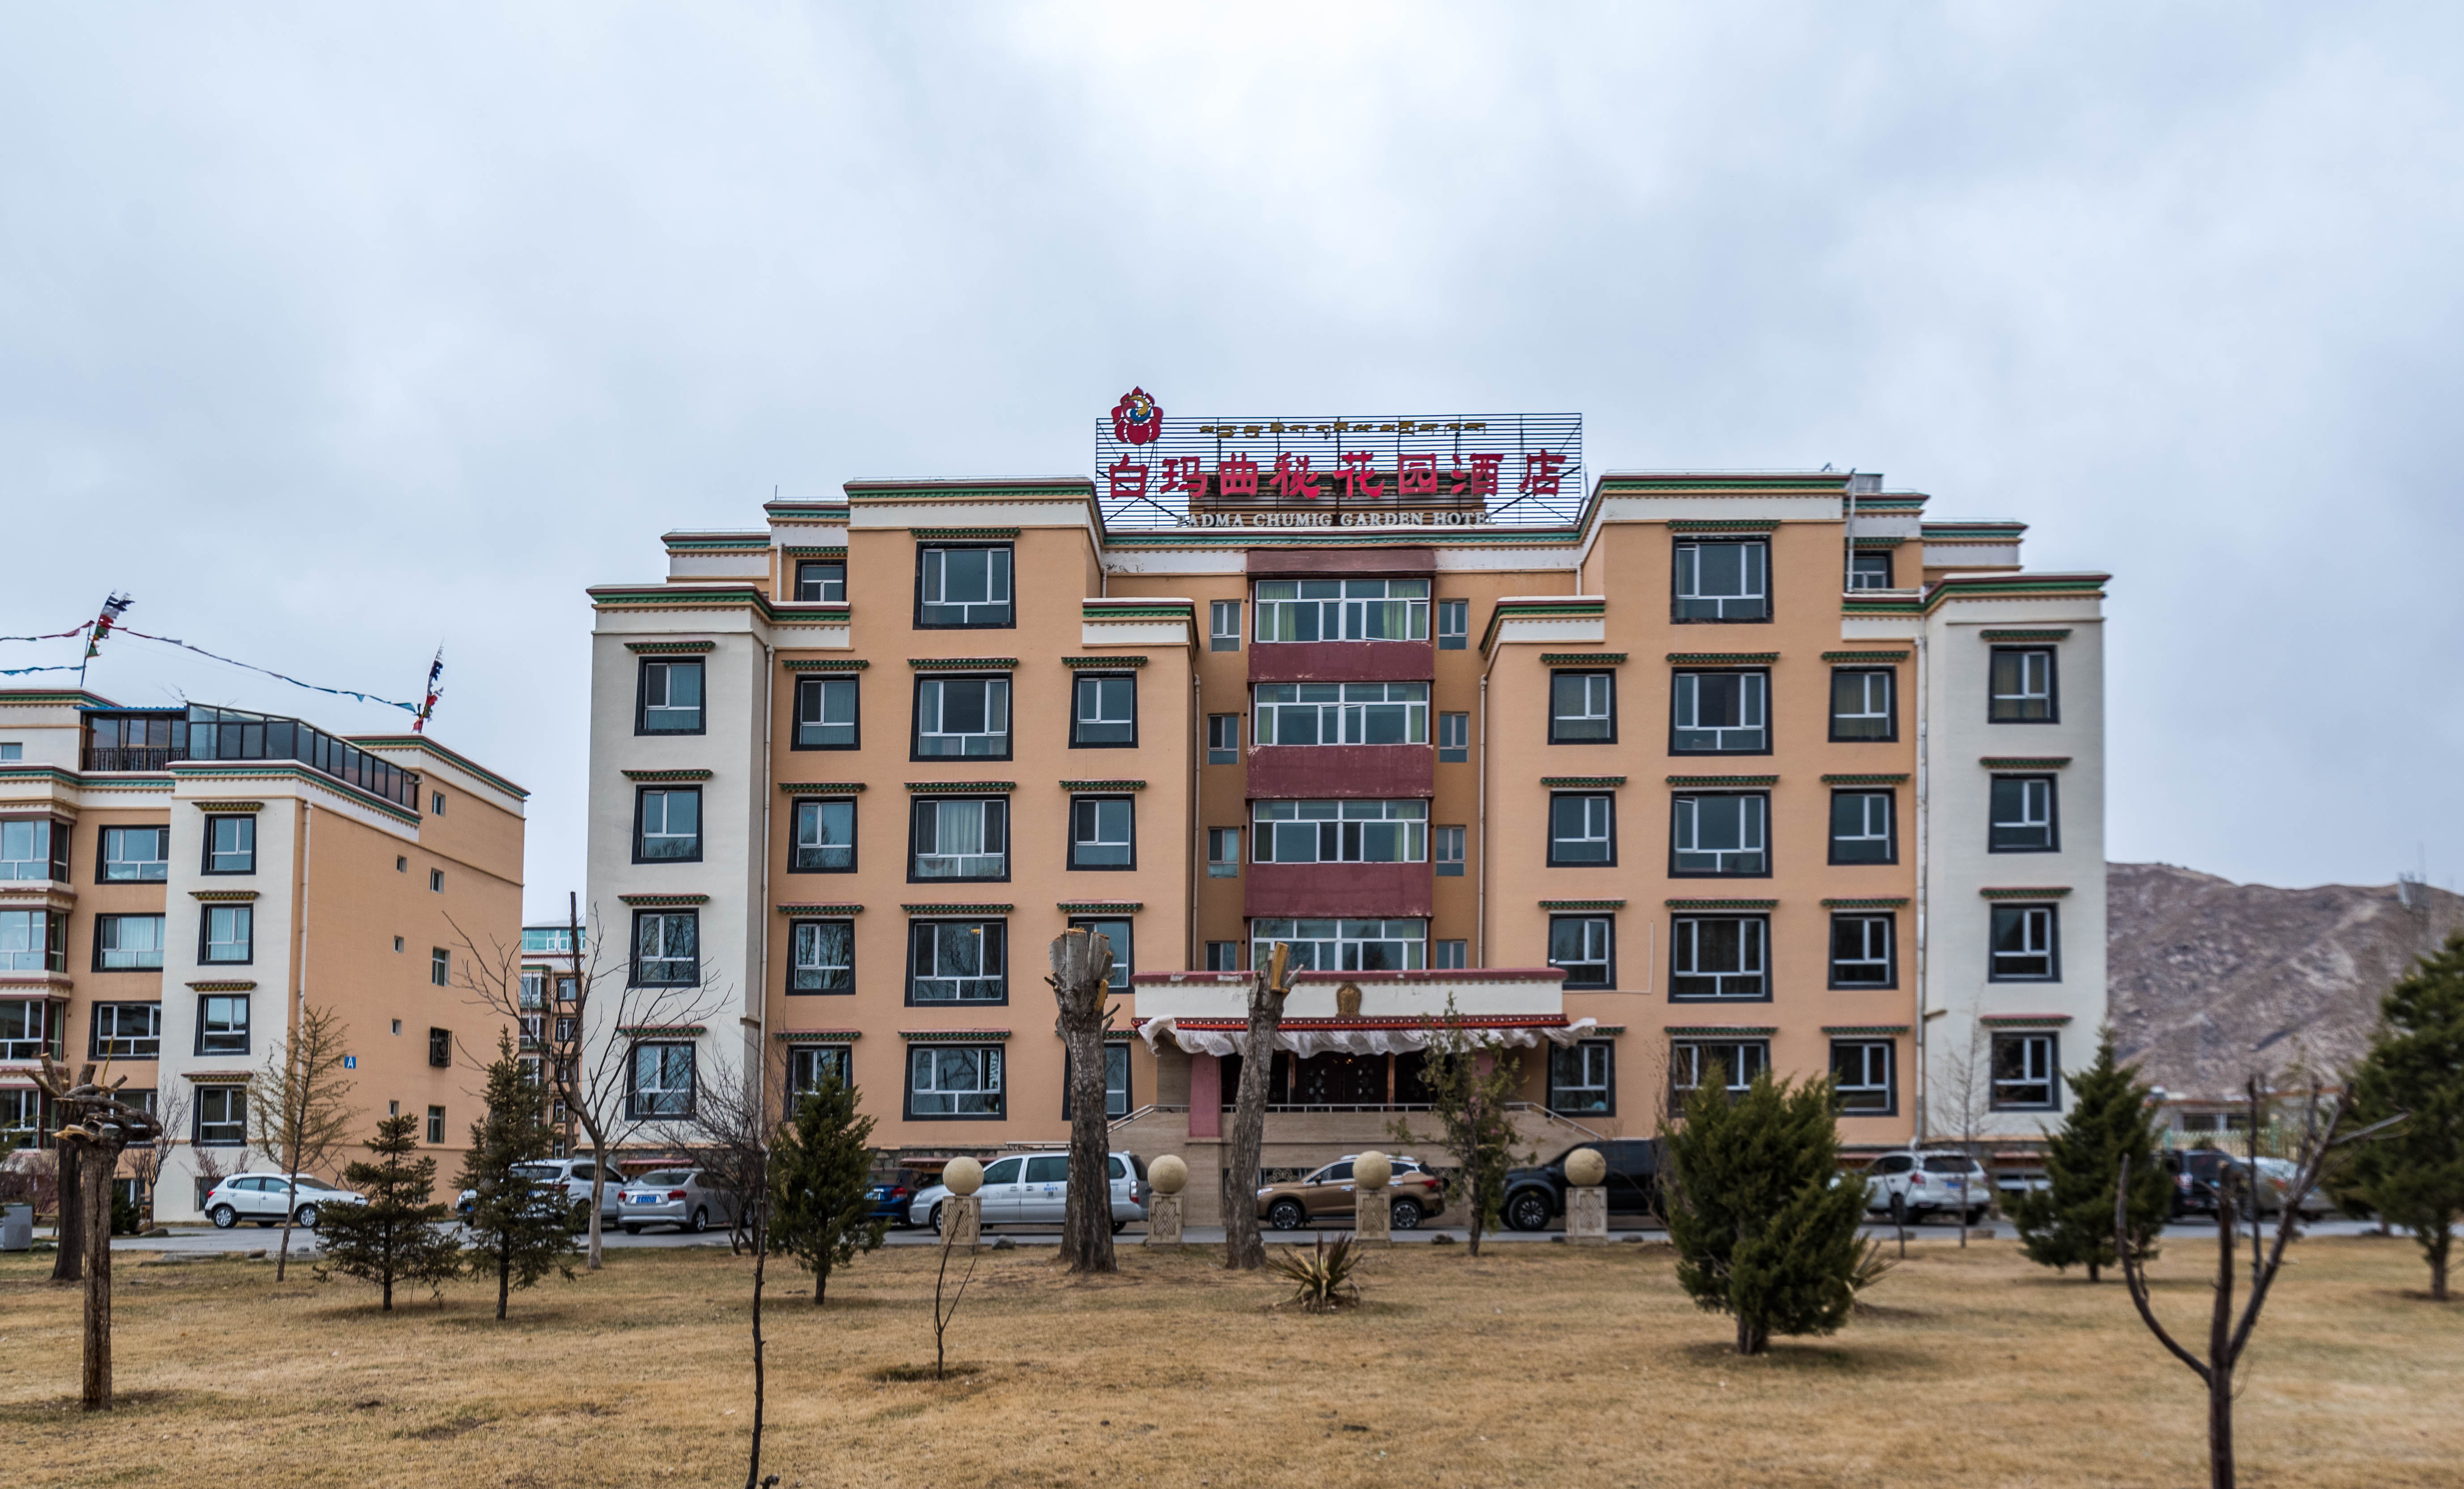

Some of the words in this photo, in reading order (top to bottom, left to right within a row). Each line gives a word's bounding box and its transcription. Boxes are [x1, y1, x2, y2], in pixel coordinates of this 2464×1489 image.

[1109, 448, 1567, 500] 白玛曲秘花园酒店
[1176, 513, 1244, 528] PADMA
[1253, 513, 1333, 527] CHUMIG
[1340, 512, 1424, 526] GARDEN
[1433, 512, 1496, 526] HOTEL
[347, 1056, 353, 1069] A
